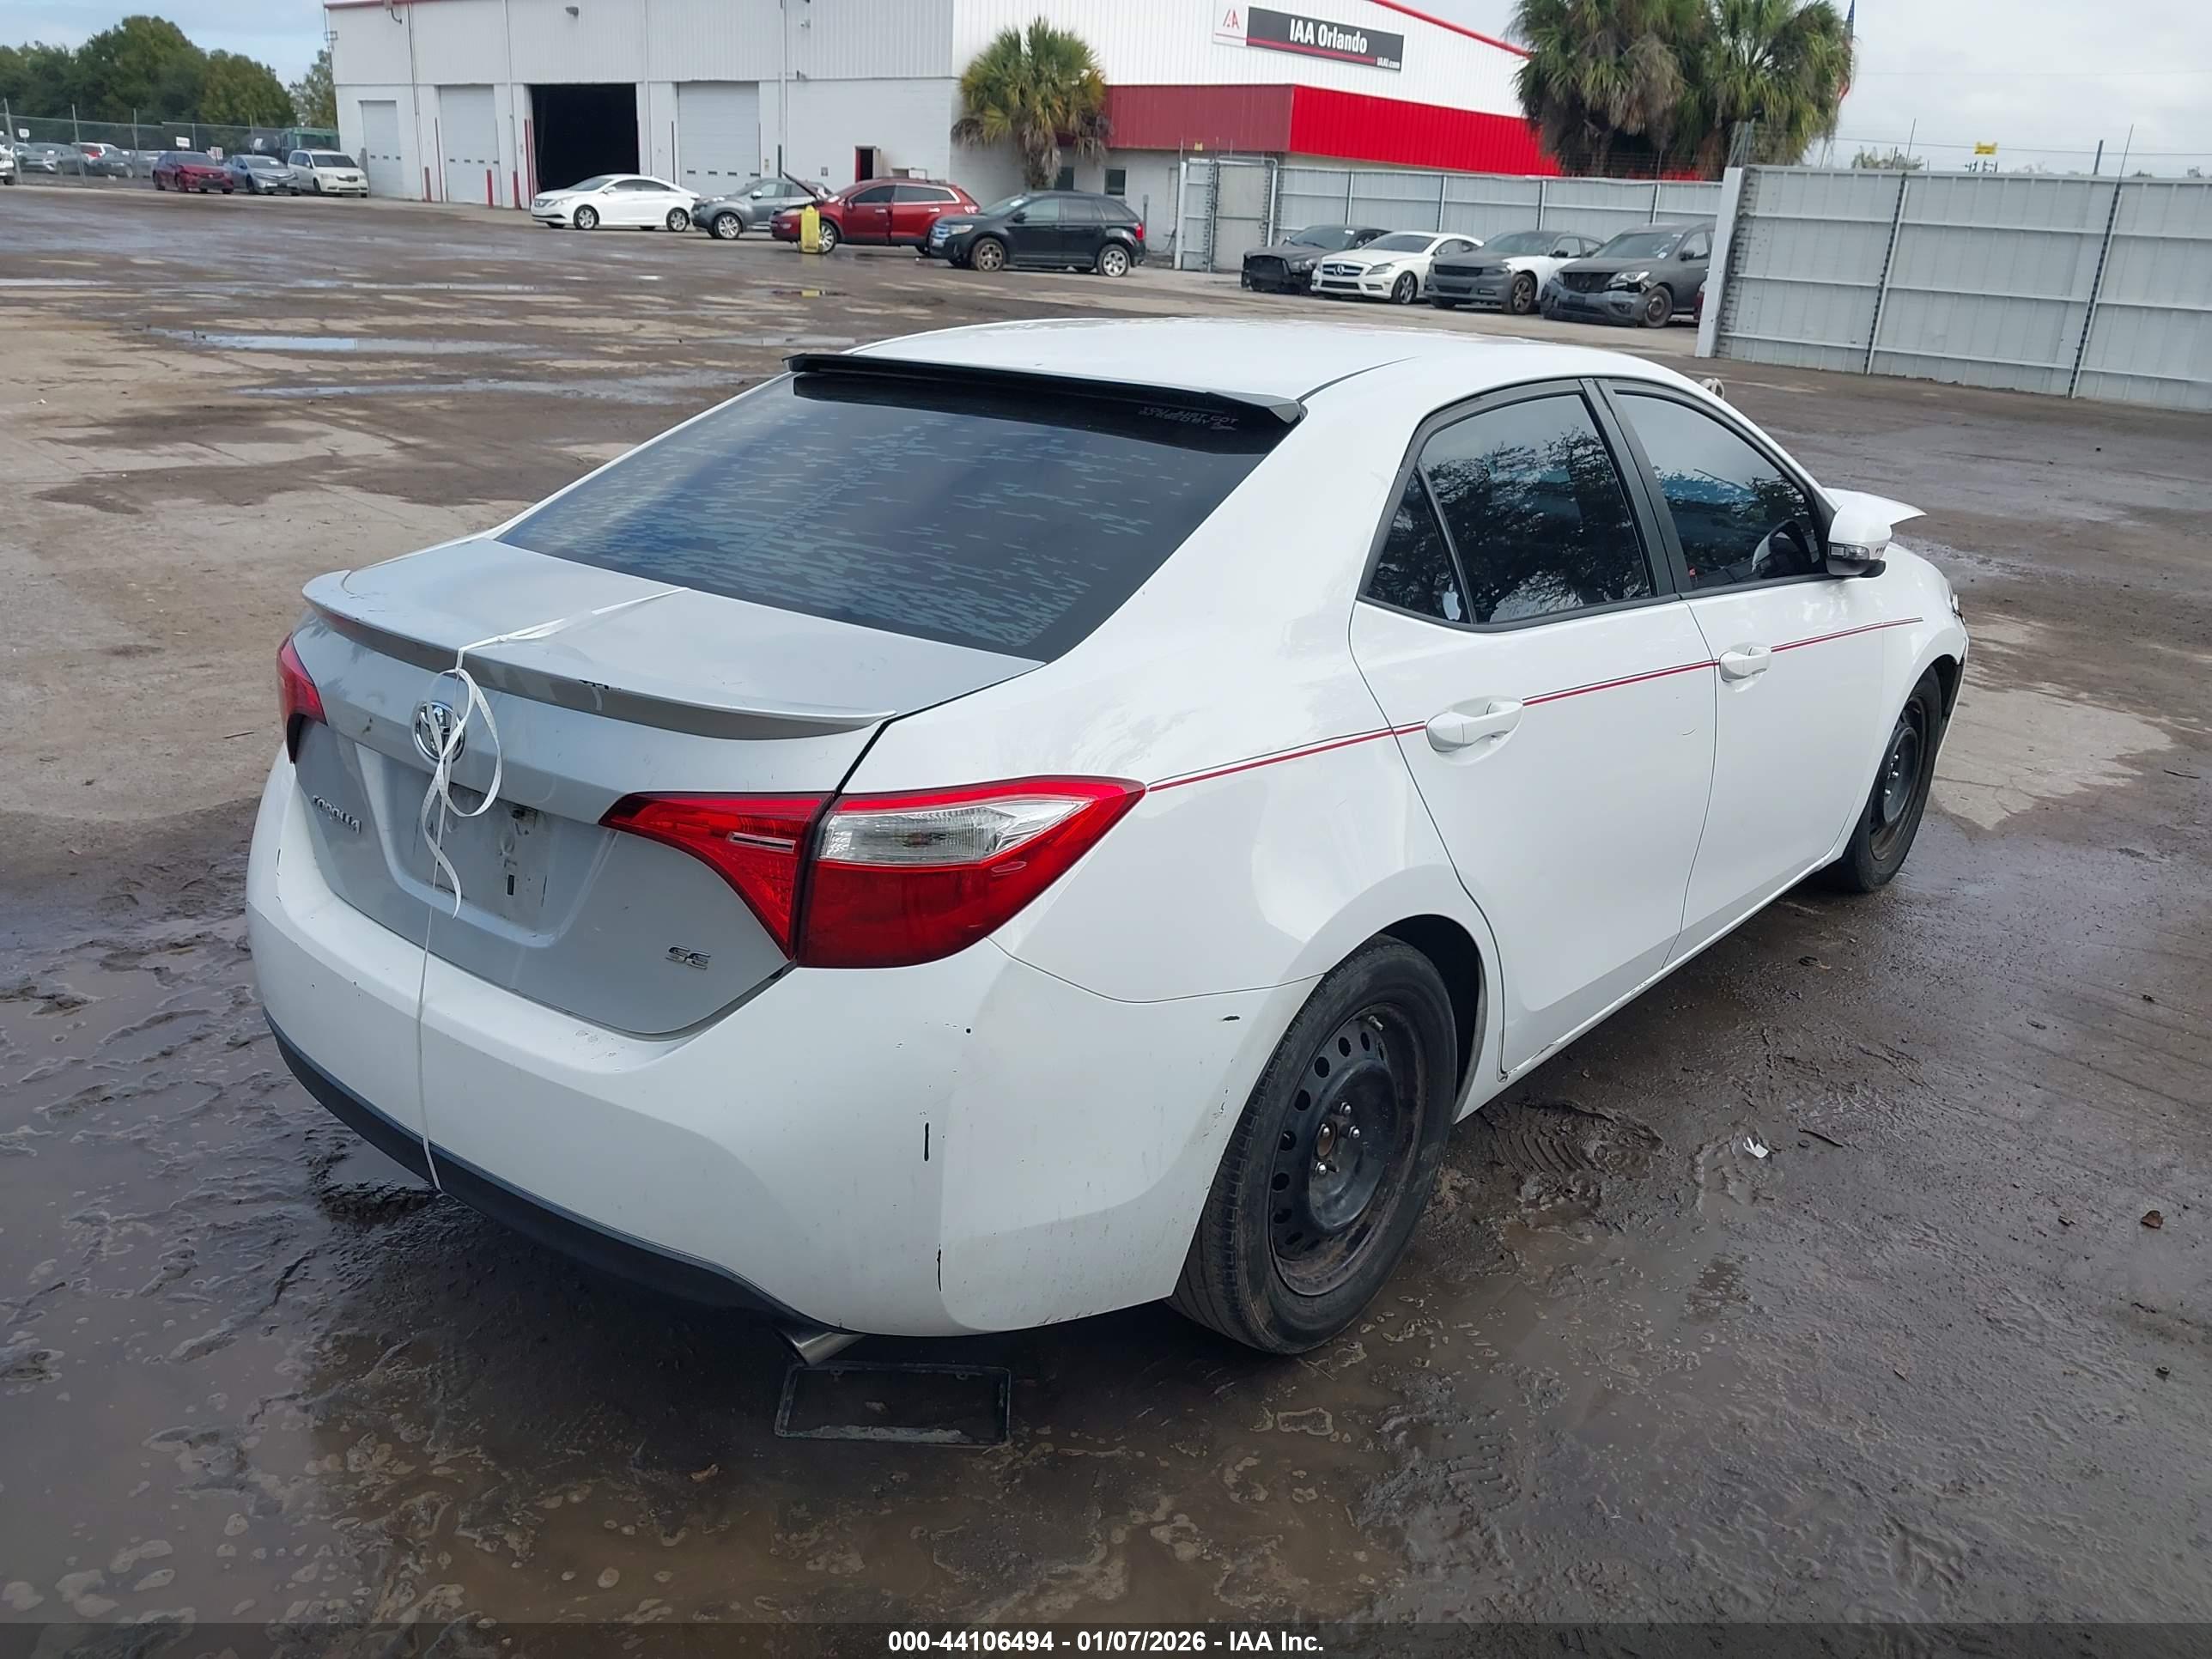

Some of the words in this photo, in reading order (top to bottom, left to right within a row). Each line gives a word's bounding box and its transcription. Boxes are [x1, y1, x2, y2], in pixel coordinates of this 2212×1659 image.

[1289, 18, 1315, 46] IAA
[1317, 20, 1368, 54] Orlando
[665, 945, 711, 969] SE
